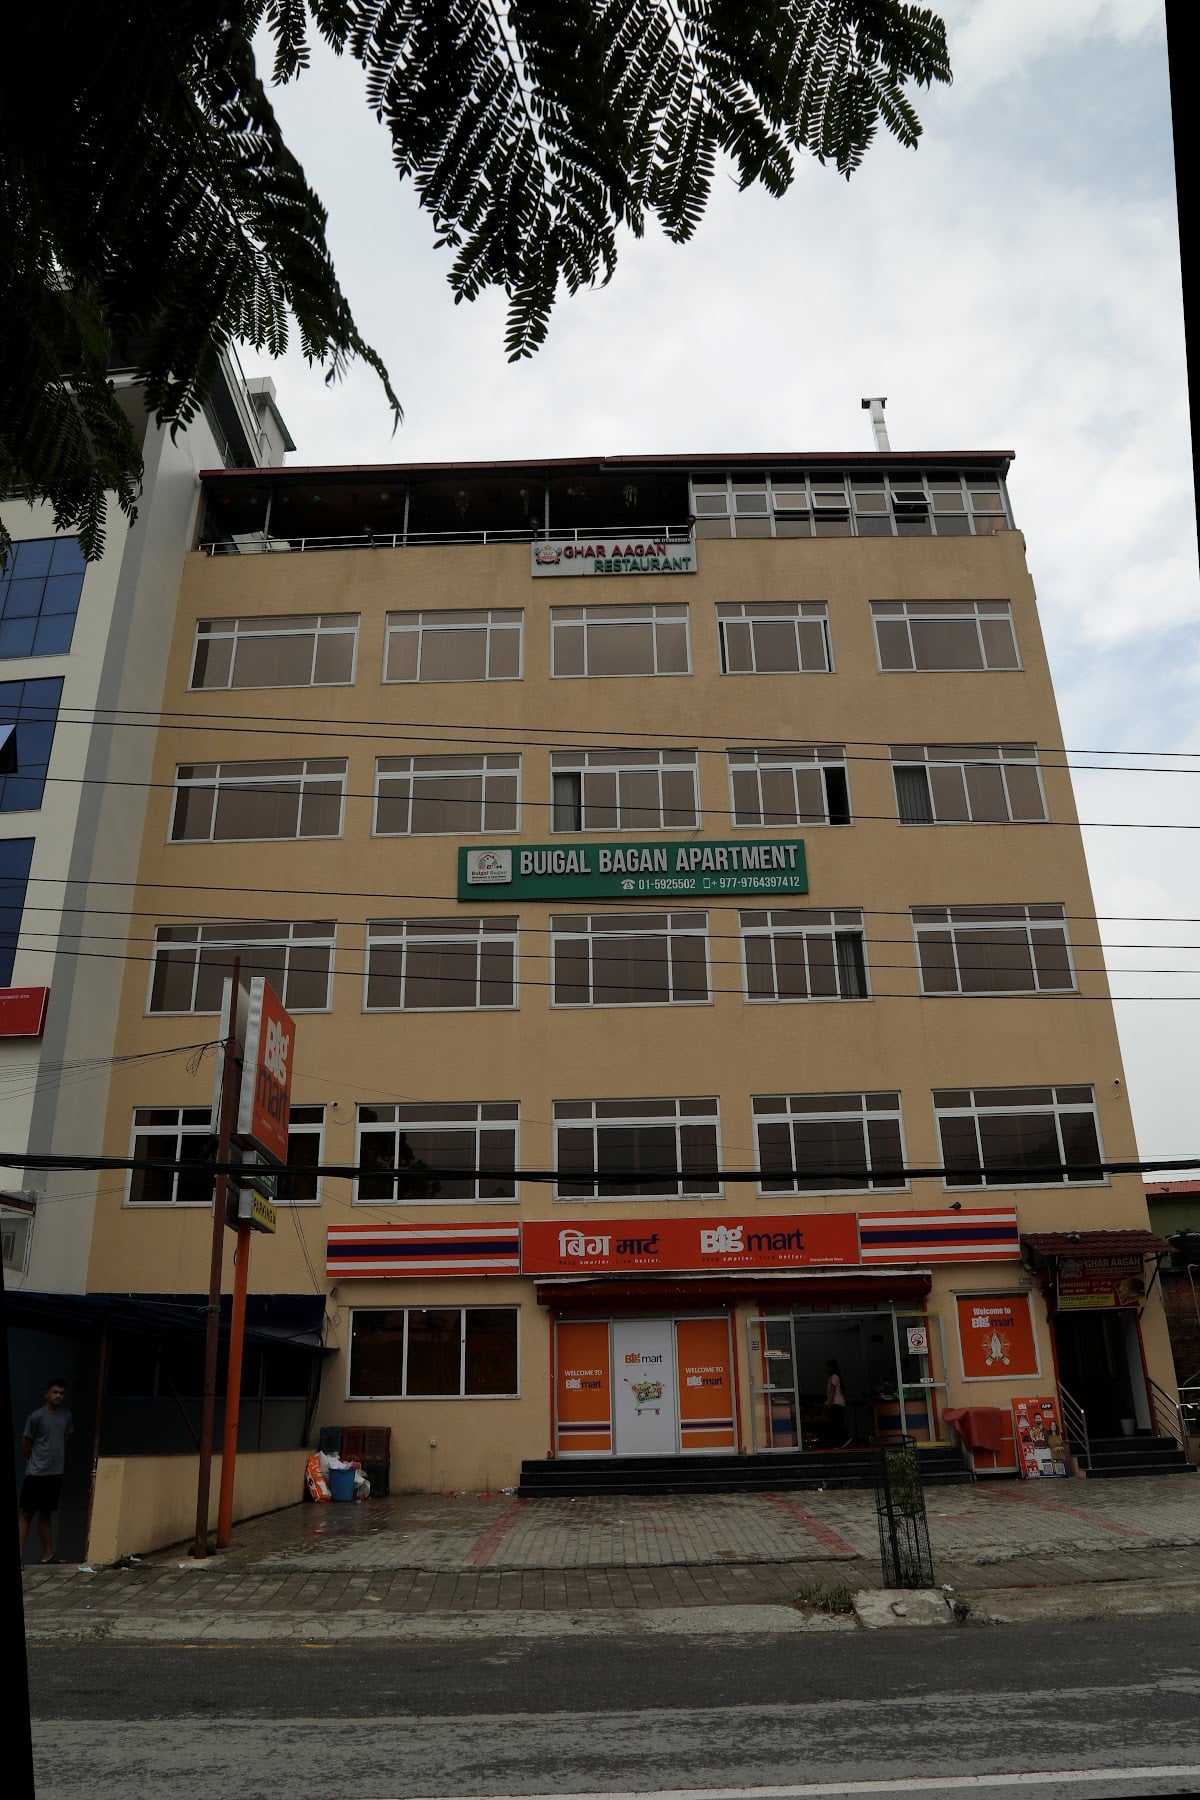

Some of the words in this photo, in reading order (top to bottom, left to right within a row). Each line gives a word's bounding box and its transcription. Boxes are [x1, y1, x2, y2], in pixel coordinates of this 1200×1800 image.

[563, 545, 606, 558] GHAR
[611, 543, 666, 557] AAGAN
[594, 556, 691, 573] RESTAURANT
[520, 849, 591, 875] BUIGAL
[599, 847, 668, 874] BAGAN
[675, 844, 798, 872] APARTMENT
[638, 879, 696, 890] 01-5925502
[264, 1016, 290, 1087] Big
[257, 1067, 288, 1131] mart
[558, 1228, 612, 1257] बिग
[615, 1233, 660, 1255] मार्ट
[700, 1224, 745, 1254] Big
[746, 1228, 805, 1252] mart
[1085, 1258, 1109, 1268] GHAR
[1110, 1257, 1141, 1267] AAGAN
[973, 1306, 1003, 1316] Welcome
[1004, 1306, 1012, 1314] to
[971, 1315, 991, 1329] Big
[991, 1317, 1014, 1328] mart
[625, 1352, 641, 1364] Big
[641, 1354, 663, 1364] mart
[564, 1369, 594, 1378] WELCOME
[594, 1369, 603, 1377] TO
[685, 1366, 714, 1375] WELCOME
[714, 1366, 723, 1374] TO
[565, 1378, 582, 1389] Big
[581, 1379, 602, 1389] mart
[686, 1375, 703, 1387] Big
[702, 1376, 723, 1387] mart
